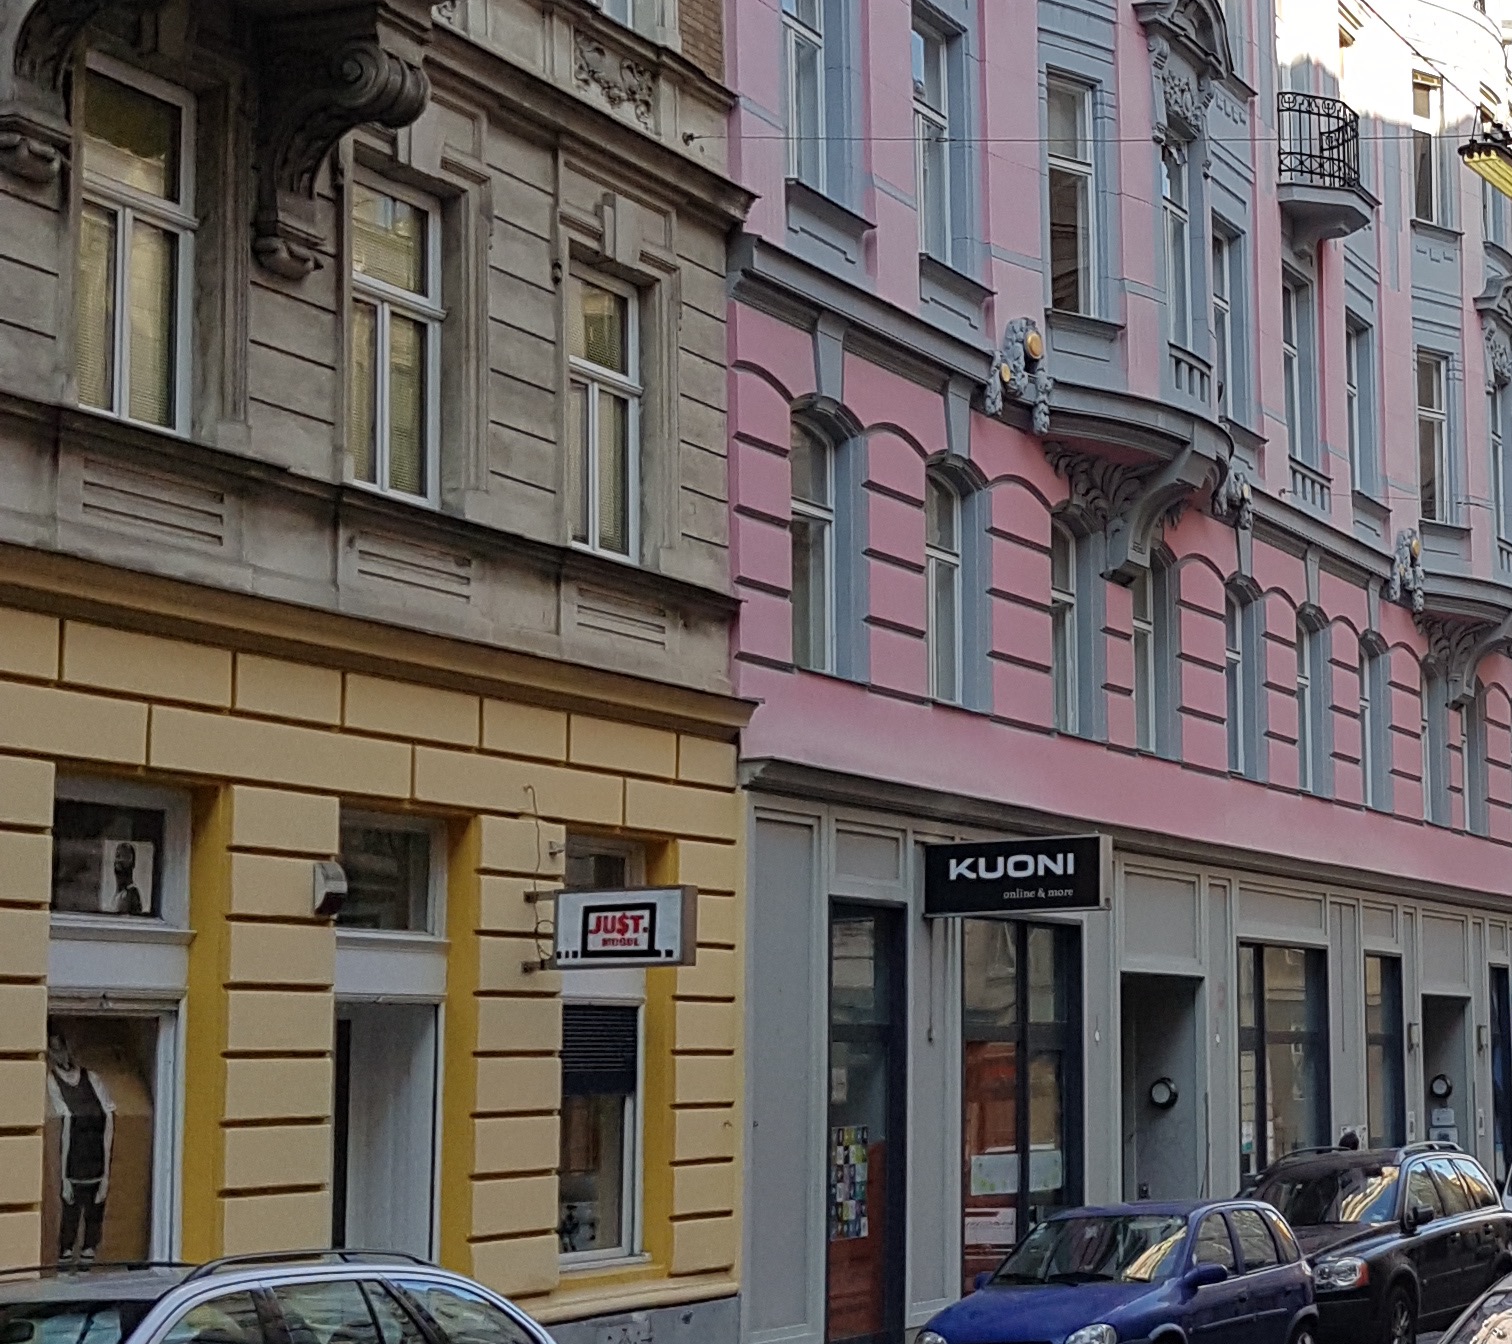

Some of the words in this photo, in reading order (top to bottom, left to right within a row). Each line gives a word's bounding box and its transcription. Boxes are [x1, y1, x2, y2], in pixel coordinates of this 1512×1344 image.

[949, 852, 1075, 881] KUONI
[1003, 889, 1036, 899] online
[1037, 888, 1046, 899] &
[1047, 887, 1074, 897] more
